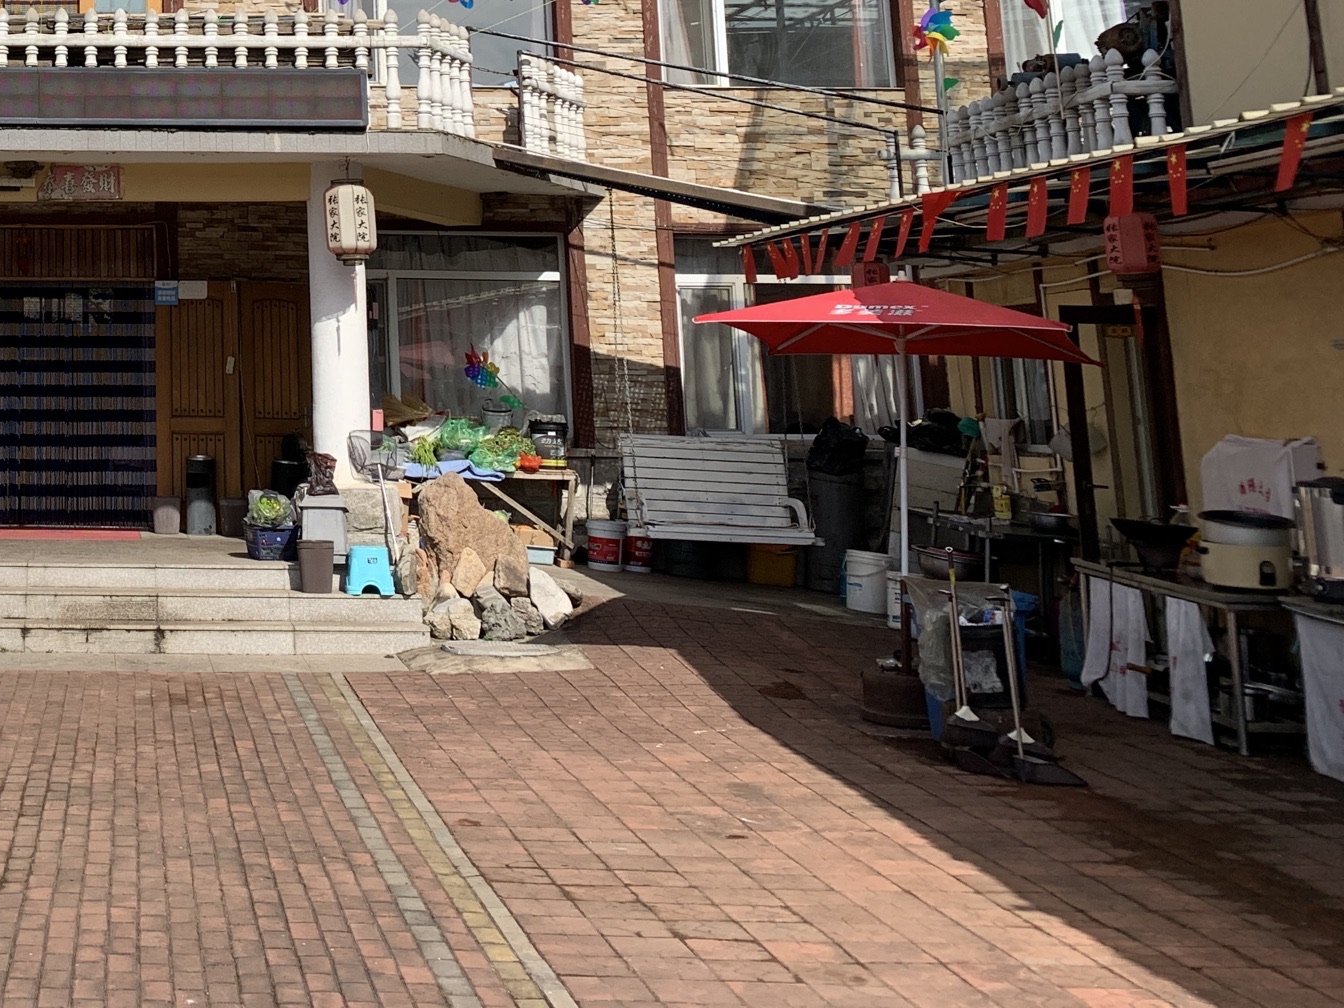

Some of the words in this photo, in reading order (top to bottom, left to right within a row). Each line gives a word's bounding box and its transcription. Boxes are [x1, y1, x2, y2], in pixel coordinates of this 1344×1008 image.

[328, 194, 341, 243] 张家大院
[354, 194, 370, 243] 张家大院
